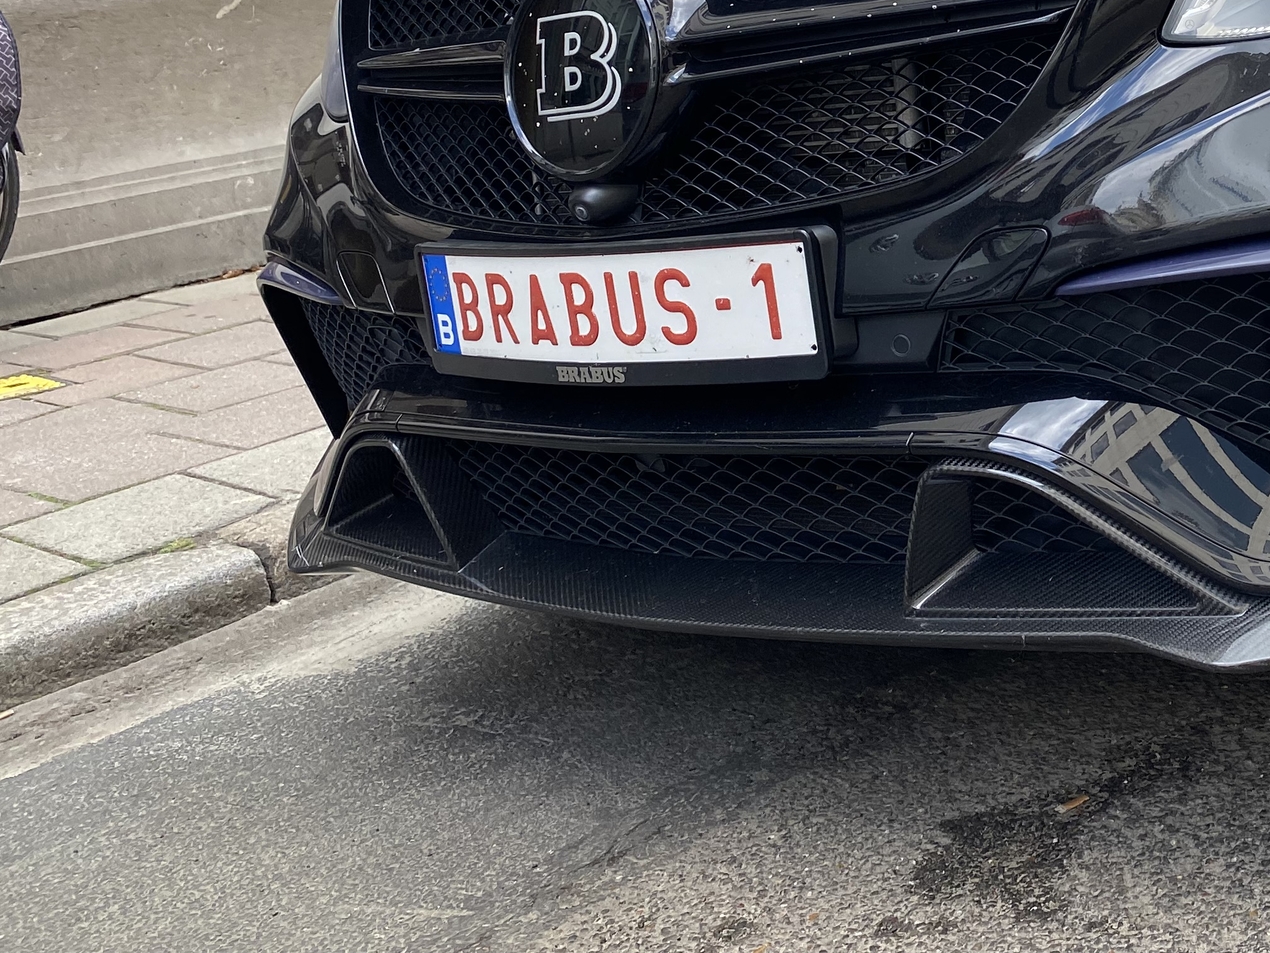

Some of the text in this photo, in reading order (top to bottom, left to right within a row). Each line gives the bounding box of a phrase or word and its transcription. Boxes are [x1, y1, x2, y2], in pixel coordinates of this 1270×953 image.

[536, 10, 622, 123] B
[438, 313, 455, 346] B
[556, 365, 626, 384] BRABUS
